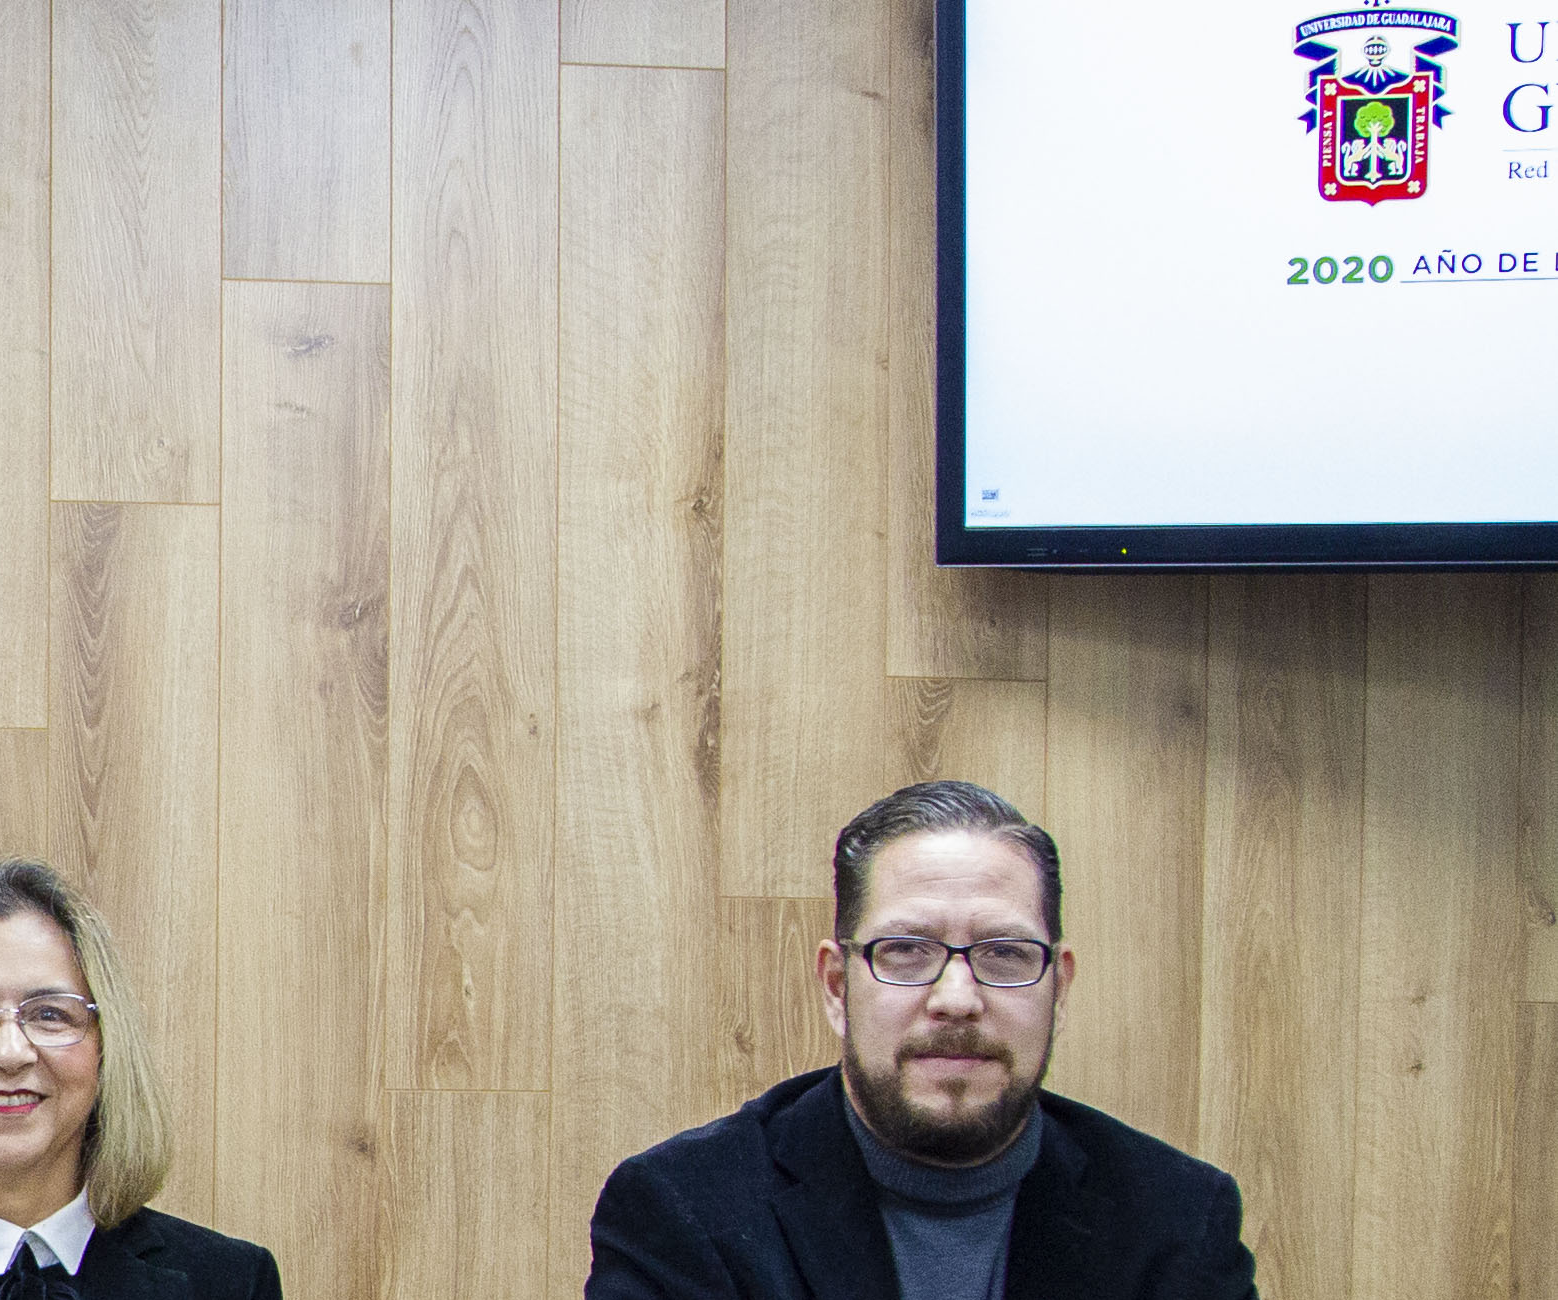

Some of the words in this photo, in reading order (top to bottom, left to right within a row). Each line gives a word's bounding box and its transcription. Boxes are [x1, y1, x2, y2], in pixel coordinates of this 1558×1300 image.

[1300, 14, 1366, 37] UNIVERSIDAD
[1367, 13, 1381, 26] DE
[1381, 12, 1452, 32] GUADALAJARA
[1506, 22, 1558, 64] U
[1323, 109, 1333, 119] Y
[1502, 83, 1558, 133] G
[1321, 121, 1334, 168] PIENSA
[1414, 106, 1426, 165] TRABAJA
[1508, 161, 1549, 179] Red
[1287, 255, 1394, 285] 2020
[1412, 249, 1483, 275] AÑO
[1498, 252, 1539, 273] DE
